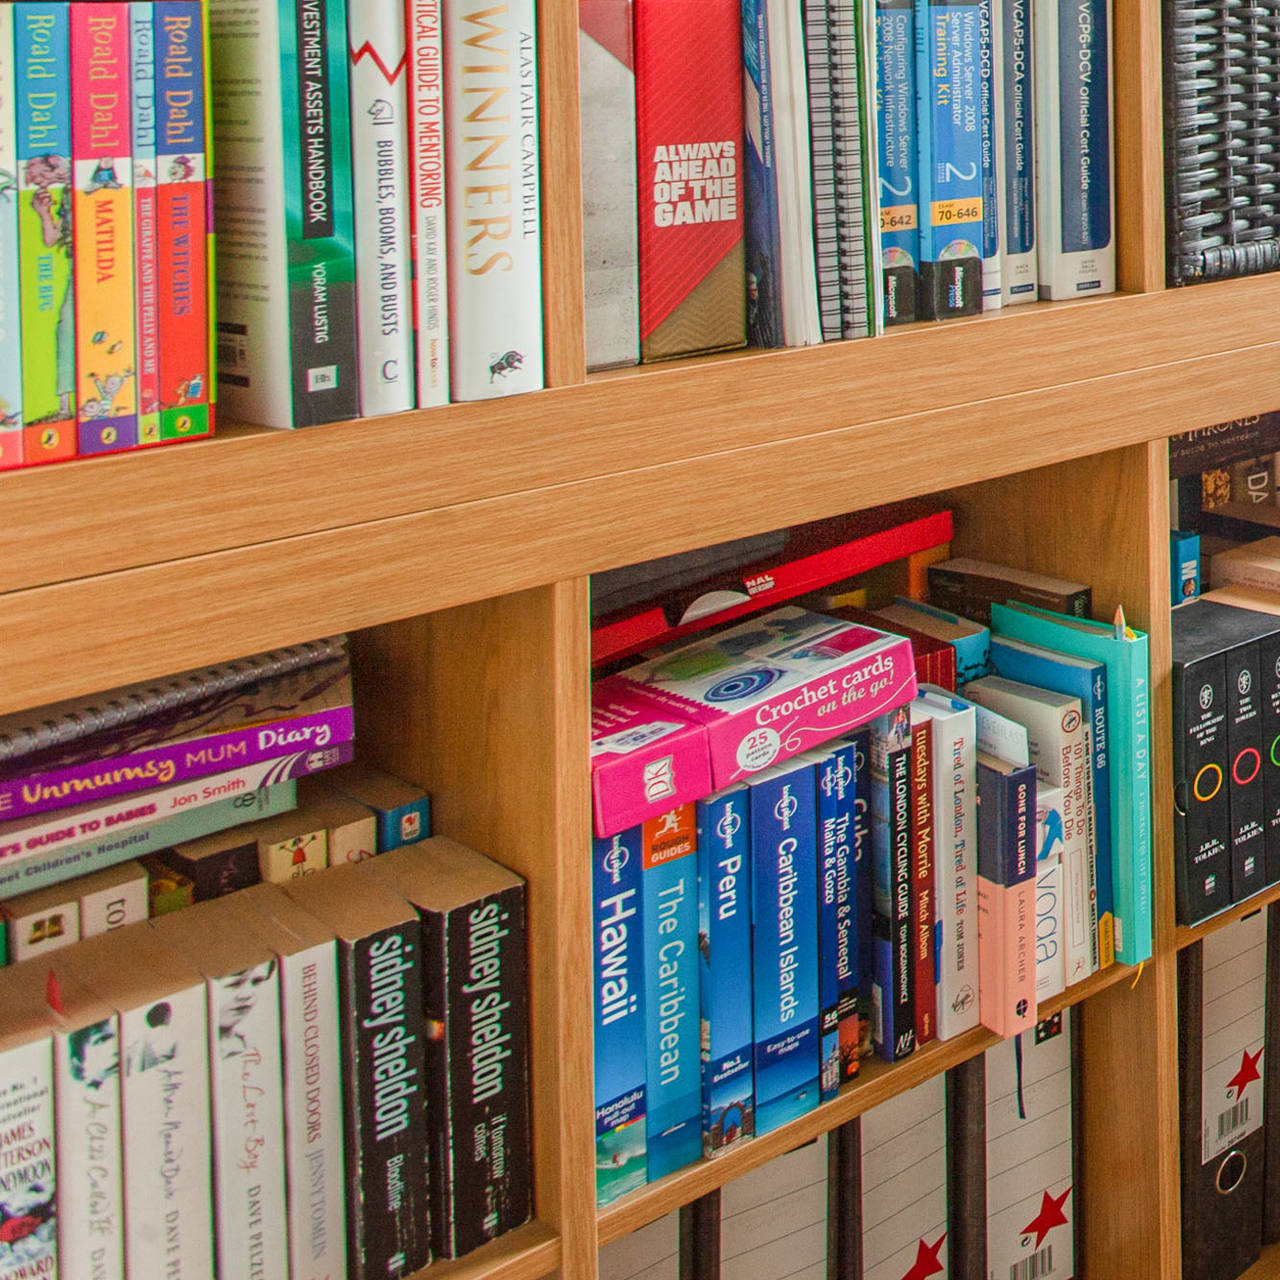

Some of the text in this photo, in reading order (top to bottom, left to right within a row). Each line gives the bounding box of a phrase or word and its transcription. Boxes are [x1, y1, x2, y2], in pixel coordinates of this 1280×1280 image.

[416, 46, 439, 92] GUIDE
[934, 13, 951, 106] Training Kit
[951, 12, 962, 126] Server Administrator
[1078, 2, 1092, 83] VCP6-DCV
[26, 15, 57, 148] Roald Dahl
[89, 15, 119, 149] Roald Dahl
[134, 20, 155, 148] Roald Dahl
[164, 15, 194, 144] Roald Dahl
[882, 16, 895, 168] 2008 Network Infrastructure
[895, 15, 909, 170] Configuring Windows Server
[963, 11, 976, 132] Windows Server 2008
[1012, 0, 1025, 171] VCAP5-DCA Official Cert Guide
[305, 81, 325, 135] ASSETS
[418, 96, 440, 116] TO
[1080, 86, 1091, 127] Official
[460, 3, 513, 277] WINNERS
[519, 31, 537, 239] ALASTAIR CAMPBELL
[654, 141, 736, 163] ALWAYS
[1080, 129, 1091, 151] Cert
[307, 137, 328, 223] HANDBOOK
[418, 121, 442, 209] MENTORING
[654, 158, 736, 182] AHEAD
[654, 178, 737, 203] OF THE
[1080, 154, 1091, 186] Guide
[376, 140, 399, 337] BUBBLES, BOOMS, AND BUSTS
[654, 197, 738, 228] GAME
[938, 208, 978, 221] 70-646
[95, 199, 115, 284] MATILDA
[171, 194, 193, 316] THE WITCHES
[312, 262, 329, 344] YORAM LUSTIG
[888, 275, 899, 319] Microsoft
[954, 266, 965, 309] Microsoft
[755, 654, 894, 727] Crochet cards
[817, 671, 895, 718] on the go!
[1235, 710, 1257, 724] TOWERS
[747, 731, 769, 747] 25
[1094, 707, 1106, 769] ROUTE 66
[1189, 714, 1225, 735] FELLOWSHIP
[22, 758, 176, 805] Unmumsy
[185, 741, 247, 769] MUM
[258, 723, 331, 750] Diary
[26, 825, 77, 851] GUIDE
[80, 820, 102, 836] TO
[104, 804, 157, 829] BABIES
[170, 790, 199, 809] Jon
[201, 777, 247, 799] Smith
[1017, 784, 1027, 814] GONE
[1062, 745, 1074, 841] Before You Die
[651, 843, 692, 864] GUIDES
[916, 729, 929, 960] tuesdays with Morrie Mitch Albom
[1017, 815, 1027, 838] FOR
[1194, 843, 1226, 865] TOLKIEN
[1234, 825, 1264, 846] TOLKIEN
[24, 846, 93, 877] Children's
[97, 832, 150, 856] Hospital
[1017, 840, 1026, 876] LUNCH
[718, 854, 742, 920] Peru
[601, 888, 638, 1026] Hawaii
[778, 838, 800, 1023] Caribbean Islands
[658, 879, 685, 1087] The Caribbean
[1017, 936, 1026, 983] ARCHER
[462, 902, 512, 1104] sidney sheldon
[240, 1046, 262, 1082] The
[364, 934, 418, 1142] sidney sheldon
[721, 1055, 742, 1070] No.1
[767, 1028, 810, 1054] Easy-to-use
[242, 1084, 266, 1133] Lost
[302, 963, 328, 1260] BEHIND CLOSED DOORS JENNY TOMLIN
[596, 1089, 644, 1119] Honolulu
[237, 1135, 266, 1170] Boy
[473, 1122, 486, 1162] comes
[248, 1184, 262, 1228] DAVE
[387, 1154, 404, 1211] Bloodline
